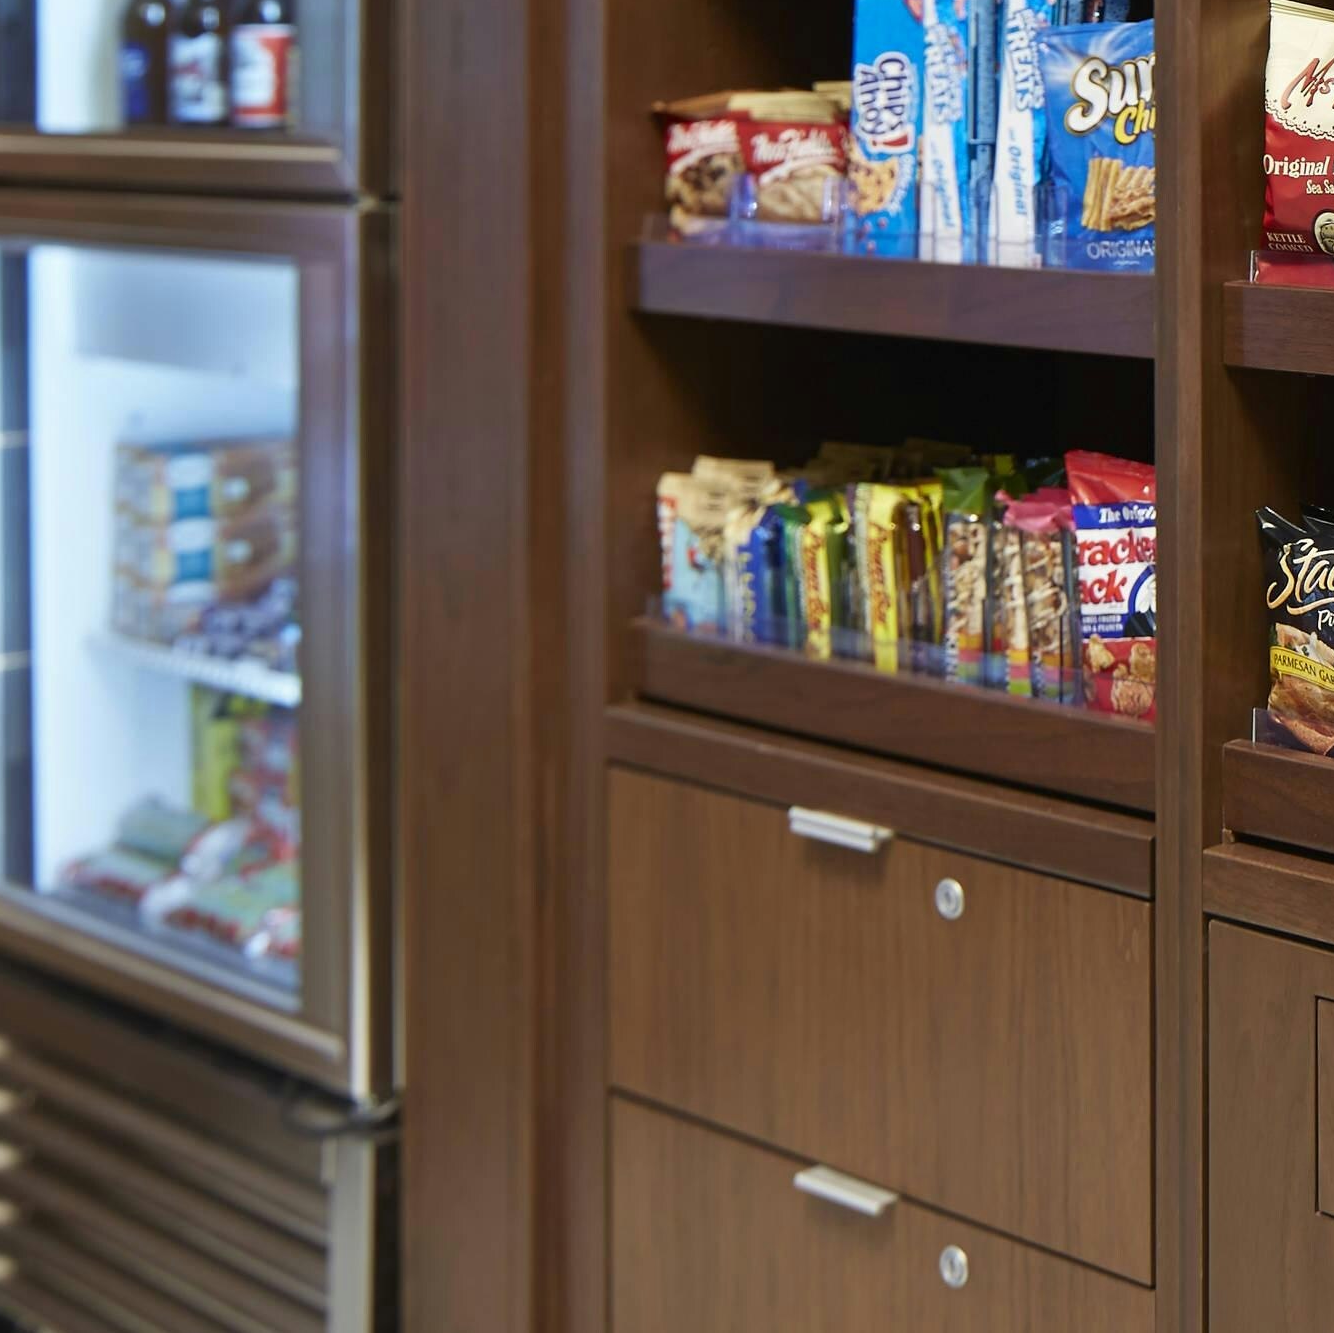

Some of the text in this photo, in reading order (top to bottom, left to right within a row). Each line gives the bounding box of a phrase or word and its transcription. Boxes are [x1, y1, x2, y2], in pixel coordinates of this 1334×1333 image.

[1006, 12, 1034, 113] TREATS
[879, 58, 907, 131] Chips
[1263, 154, 1330, 178] Original
[1007, 145, 1028, 216] Original
[1306, 179, 1324, 194] Sea
[1086, 239, 1155, 261] ORIGINA
[1266, 232, 1307, 244] KETTLE
[1099, 507, 1121, 524] The
[1273, 652, 1317, 677] PARMESAN
